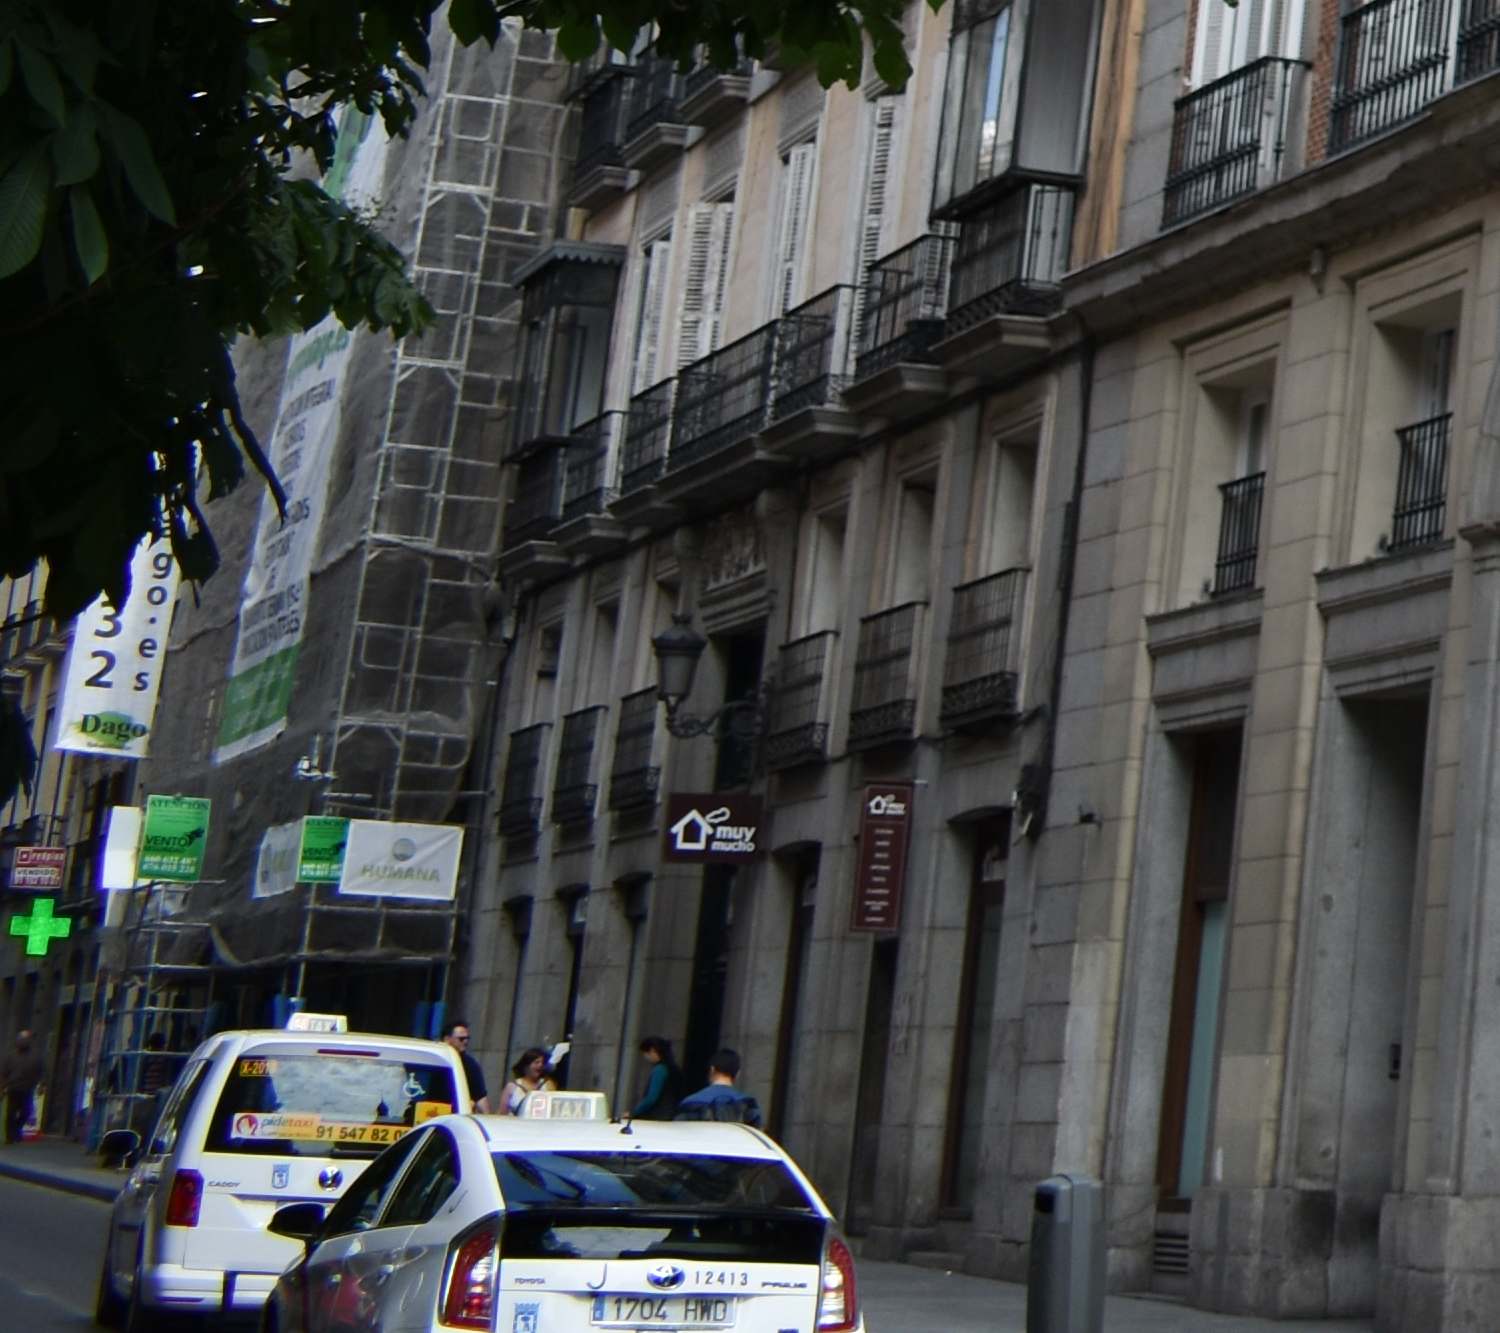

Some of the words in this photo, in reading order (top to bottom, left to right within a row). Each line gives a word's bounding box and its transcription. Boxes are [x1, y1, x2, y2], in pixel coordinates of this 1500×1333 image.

[79, 713, 148, 742] Dago
[145, 834, 188, 848] VENTO
[715, 825, 756, 842] muy
[710, 840, 756, 853] mucho
[360, 864, 441, 882] HUMANA
[261, 1115, 314, 1130] pidetaxi
[316, 1125, 333, 1138] 91
[339, 1126, 367, 1140] 547
[371, 1129, 389, 1142] 82
[694, 1270, 750, 1286] 12413
[613, 1298, 669, 1321] 1704
[683, 1298, 728, 1322] HWD
